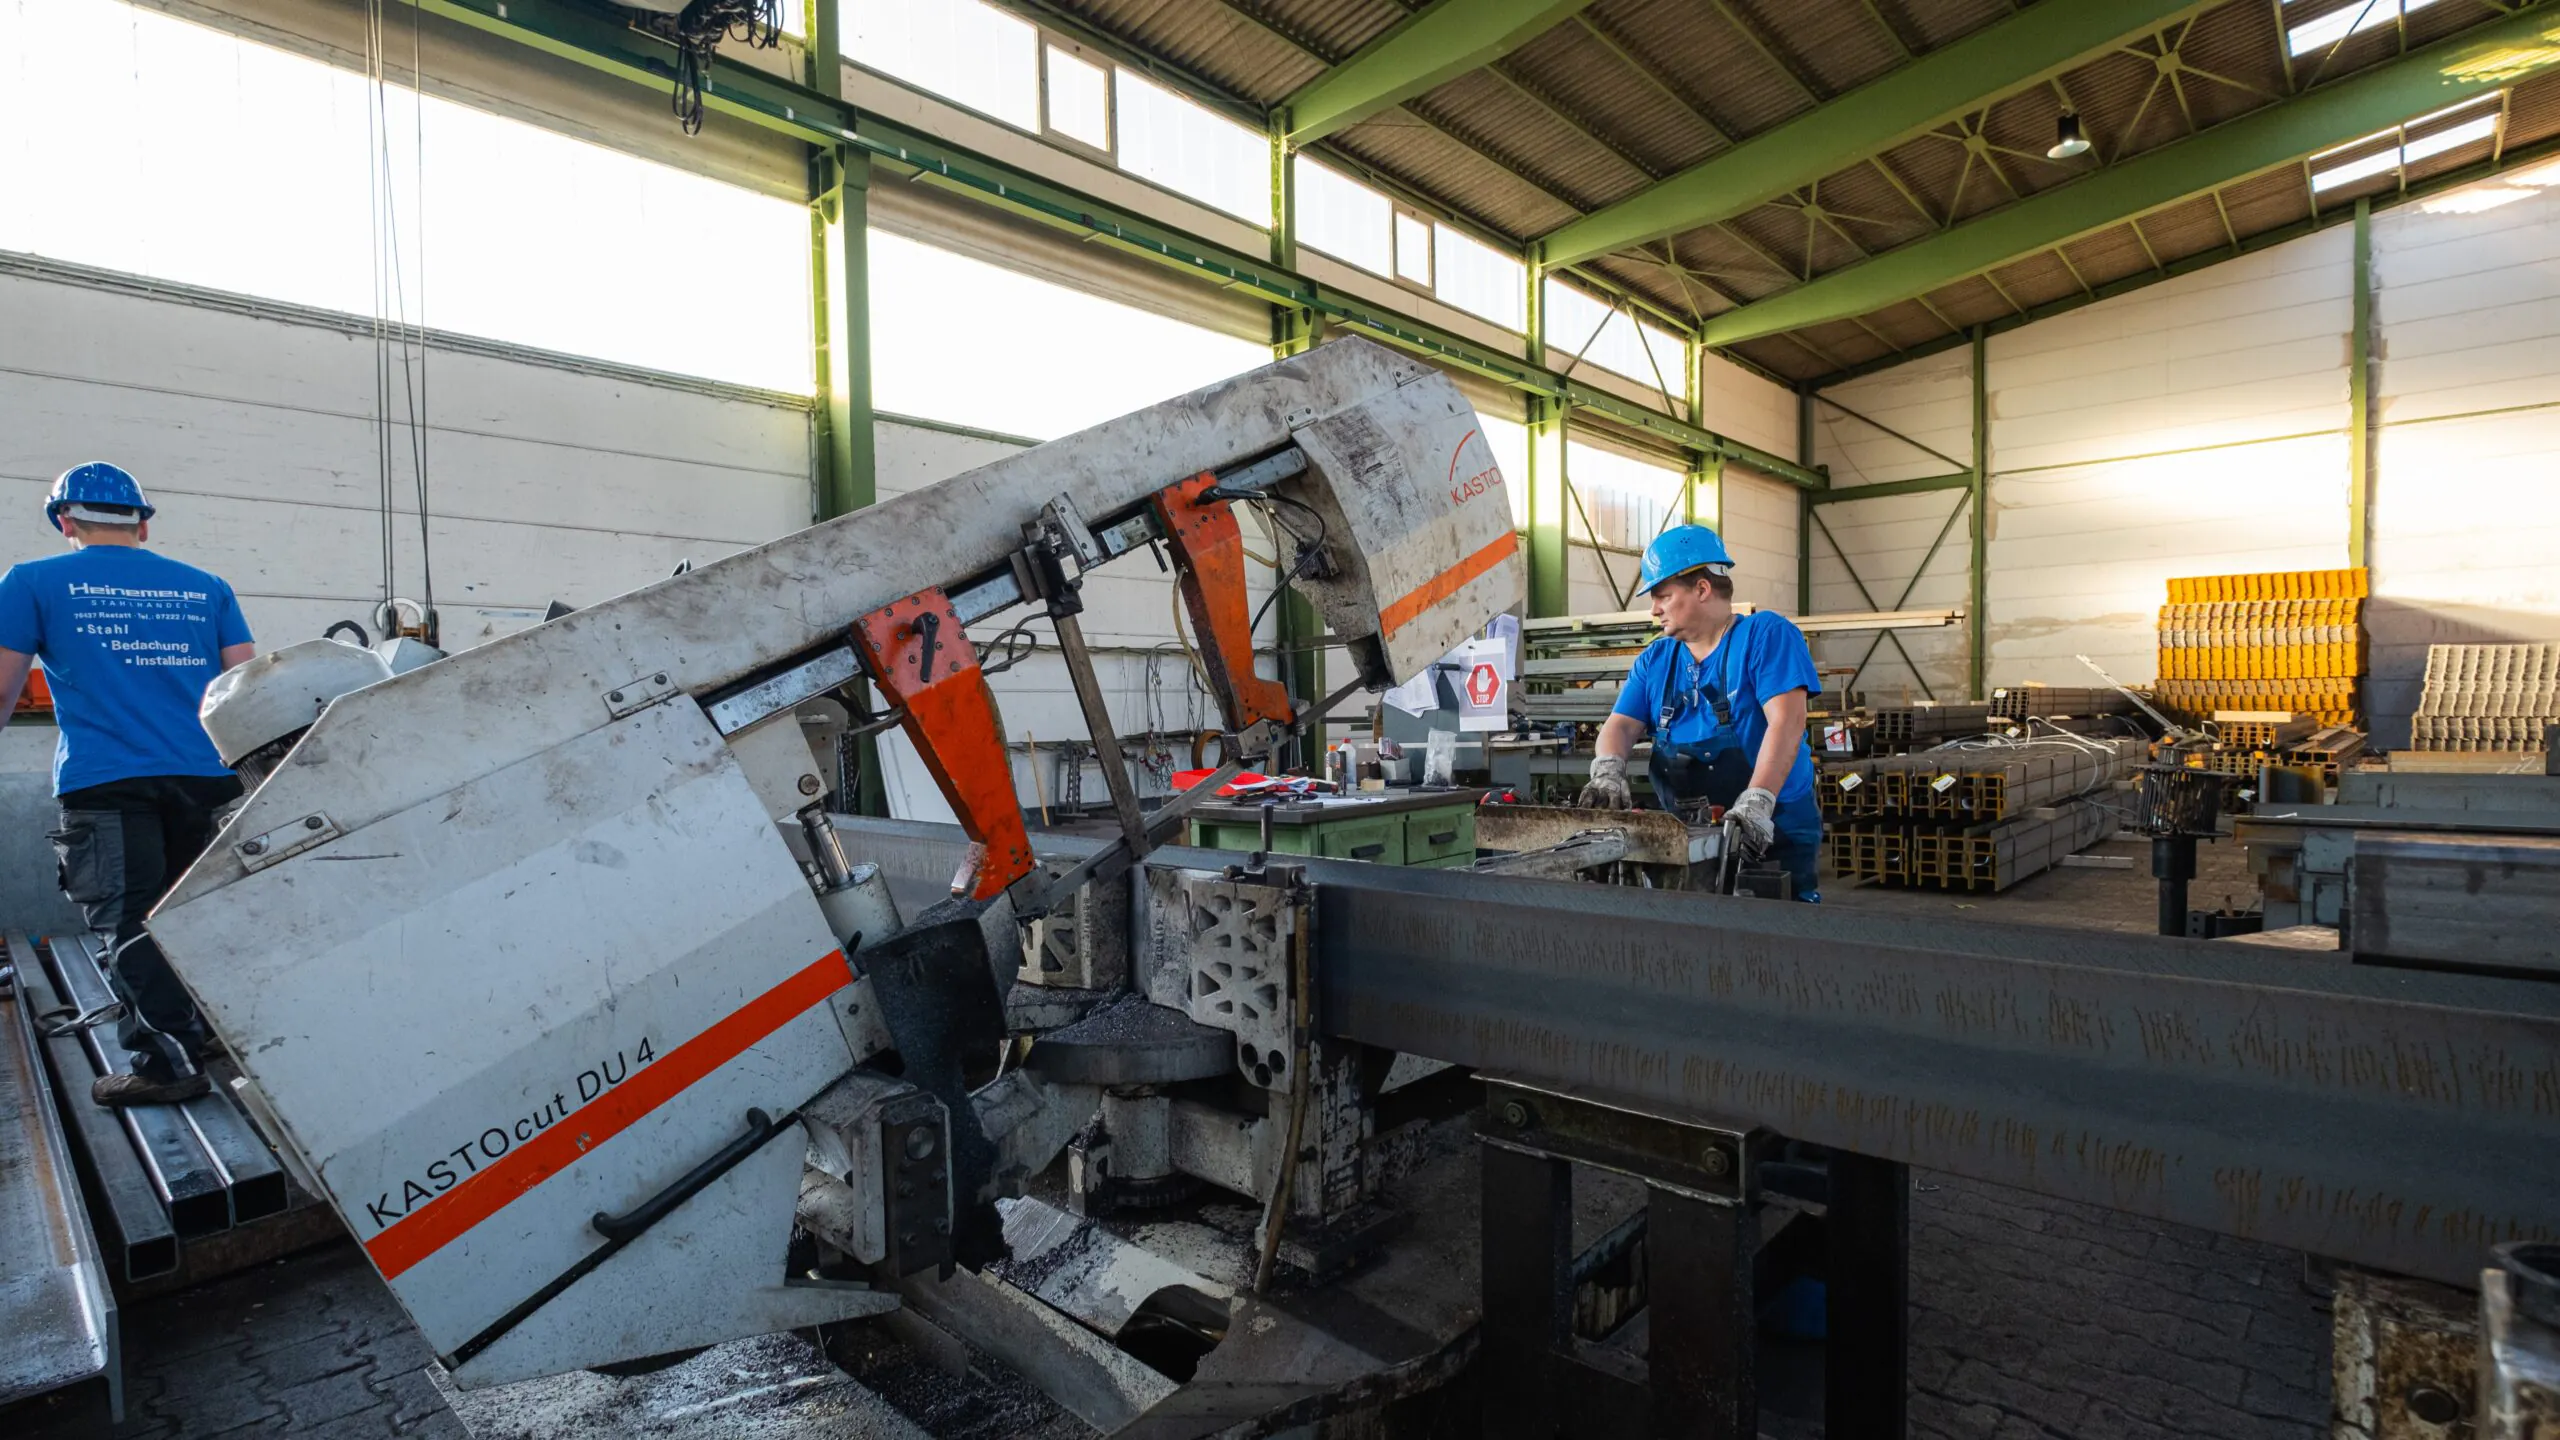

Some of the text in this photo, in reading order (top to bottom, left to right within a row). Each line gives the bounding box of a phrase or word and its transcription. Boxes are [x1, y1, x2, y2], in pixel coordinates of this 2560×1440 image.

[1450, 467, 1502, 507] KASTO
[68, 582, 208, 601] Heinemeyer
[87, 624, 129, 634] Stahl
[111, 640, 189, 653] Bedachung
[136, 655, 207, 666] Installation
[1476, 694, 1490, 704] STOP
[366, 1036, 656, 1229] KASTOcut DU 4
